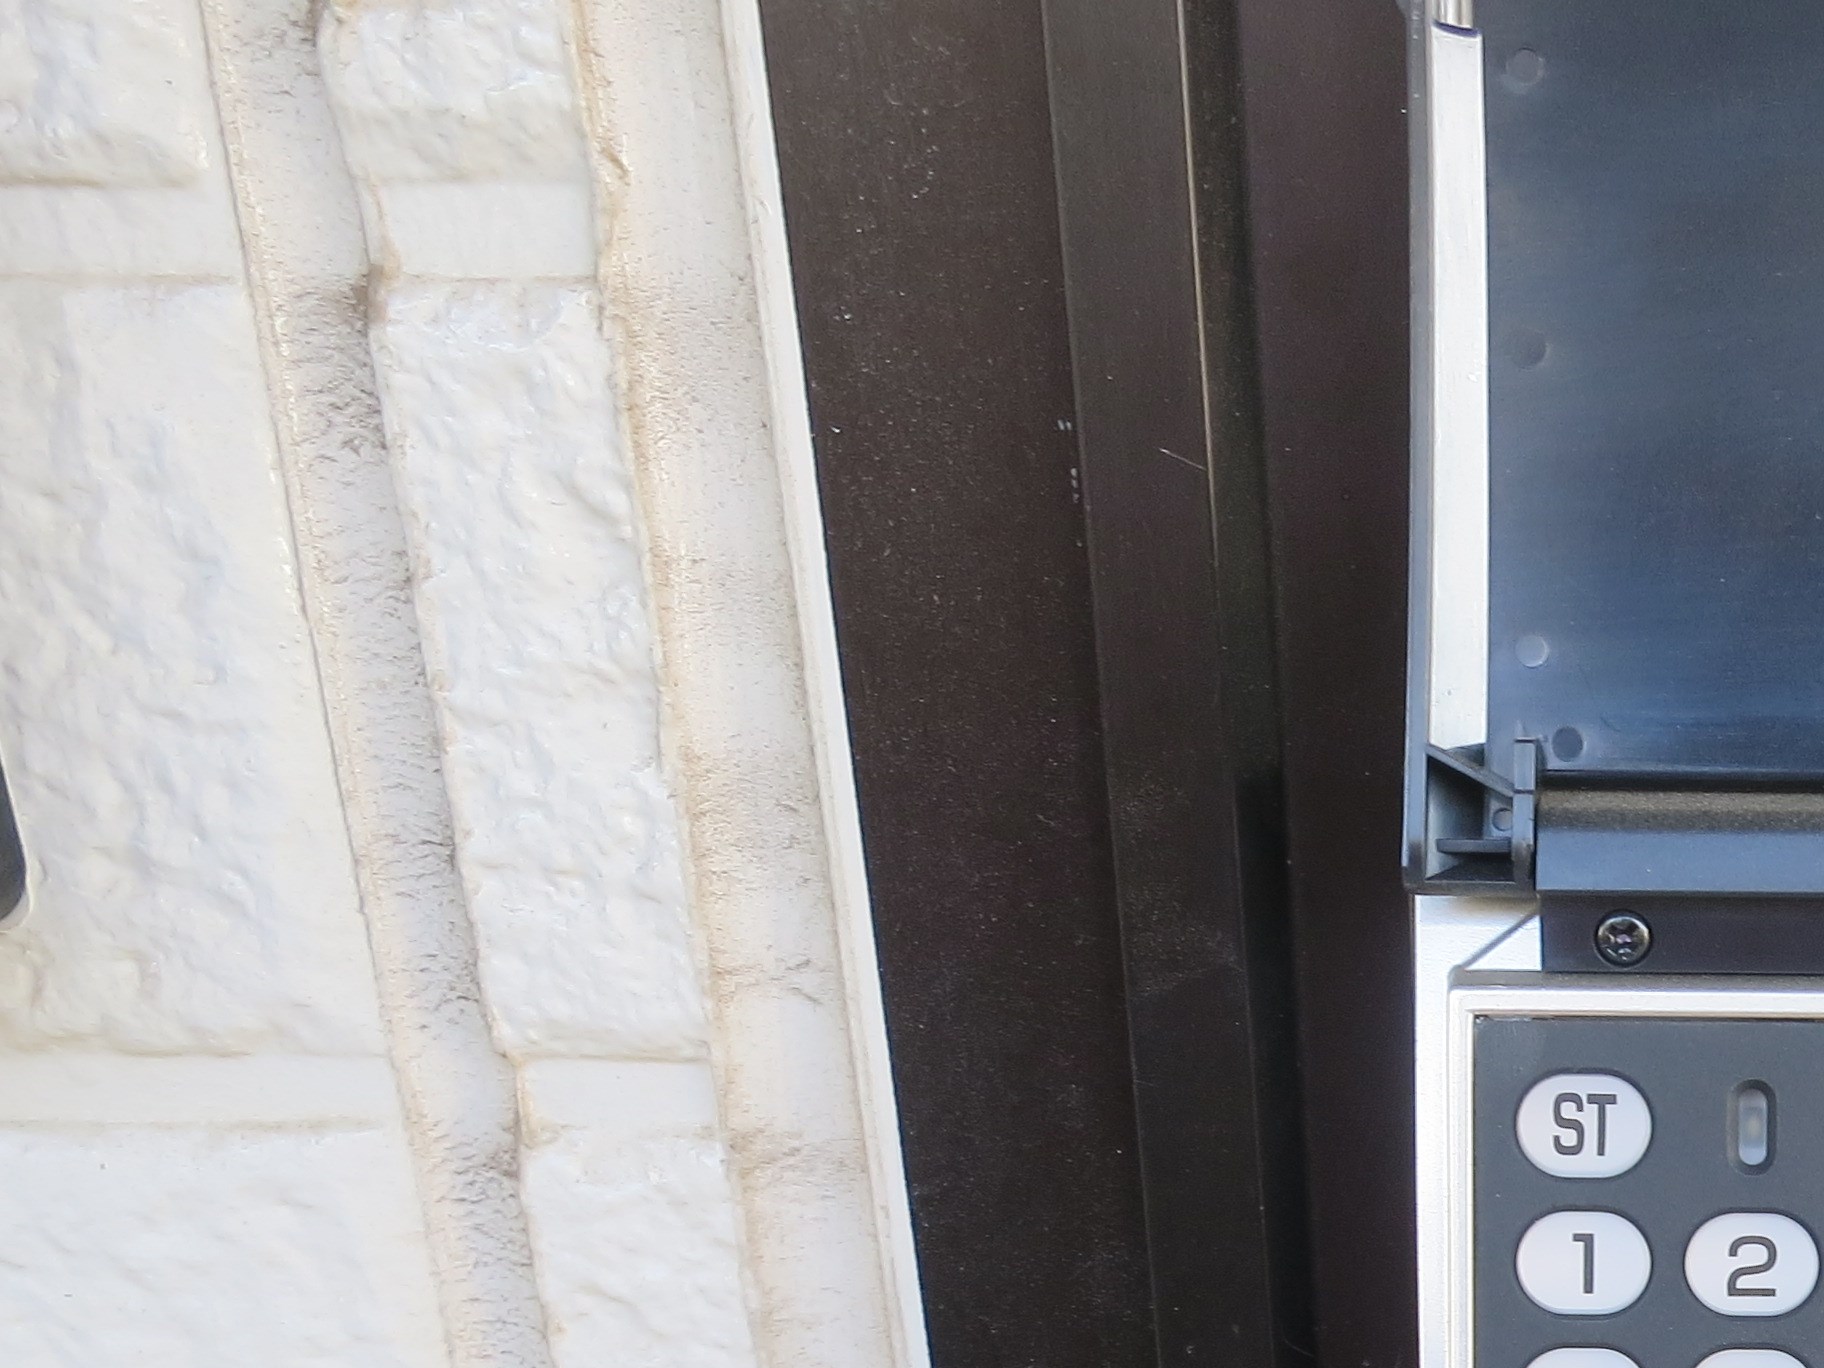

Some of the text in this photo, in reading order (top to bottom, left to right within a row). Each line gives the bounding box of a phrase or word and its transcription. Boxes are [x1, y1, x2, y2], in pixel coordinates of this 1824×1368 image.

[1552, 1092, 1618, 1157] ST
[1572, 1232, 1595, 1295] 1
[1726, 1235, 1778, 1298] 2
